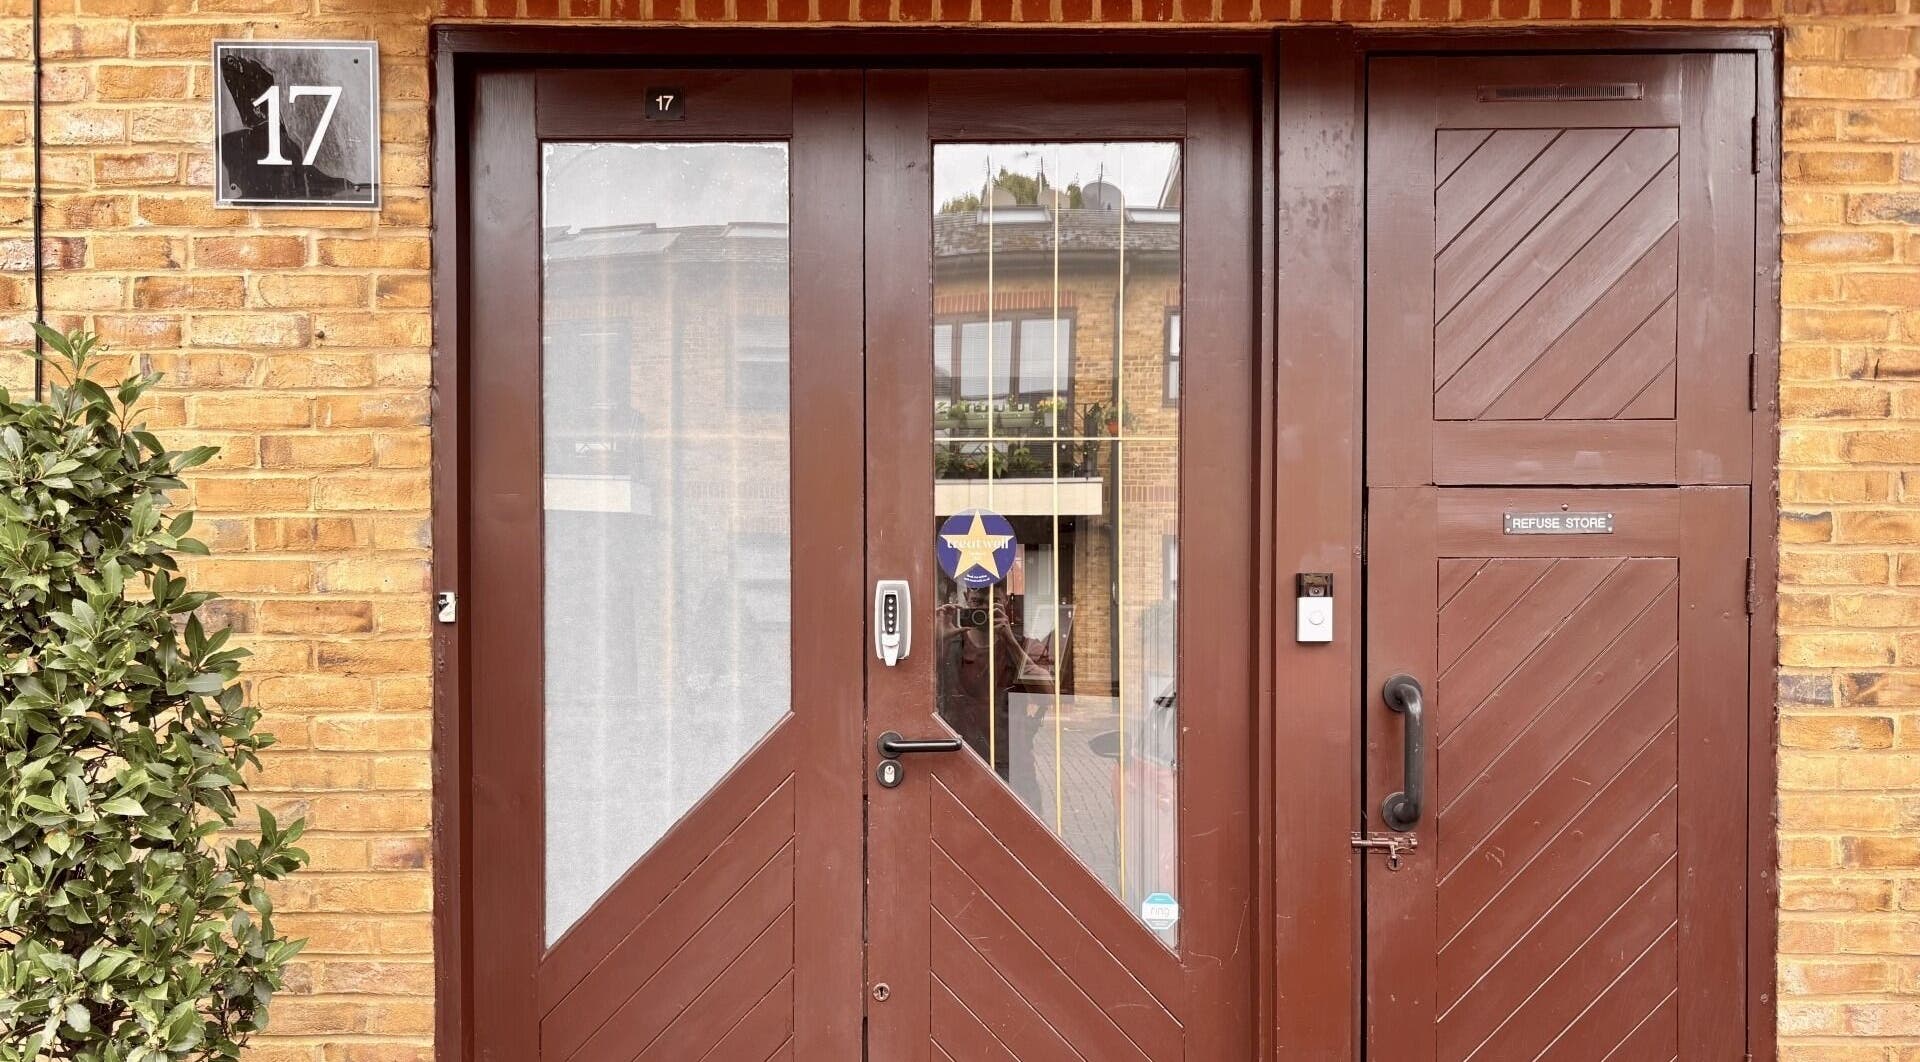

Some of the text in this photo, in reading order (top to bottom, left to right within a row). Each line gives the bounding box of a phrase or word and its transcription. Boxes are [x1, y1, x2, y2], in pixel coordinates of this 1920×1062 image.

[655, 95, 674, 111] 17
[252, 85, 343, 166] 17
[1512, 517, 1607, 529] REFUSE STORE
